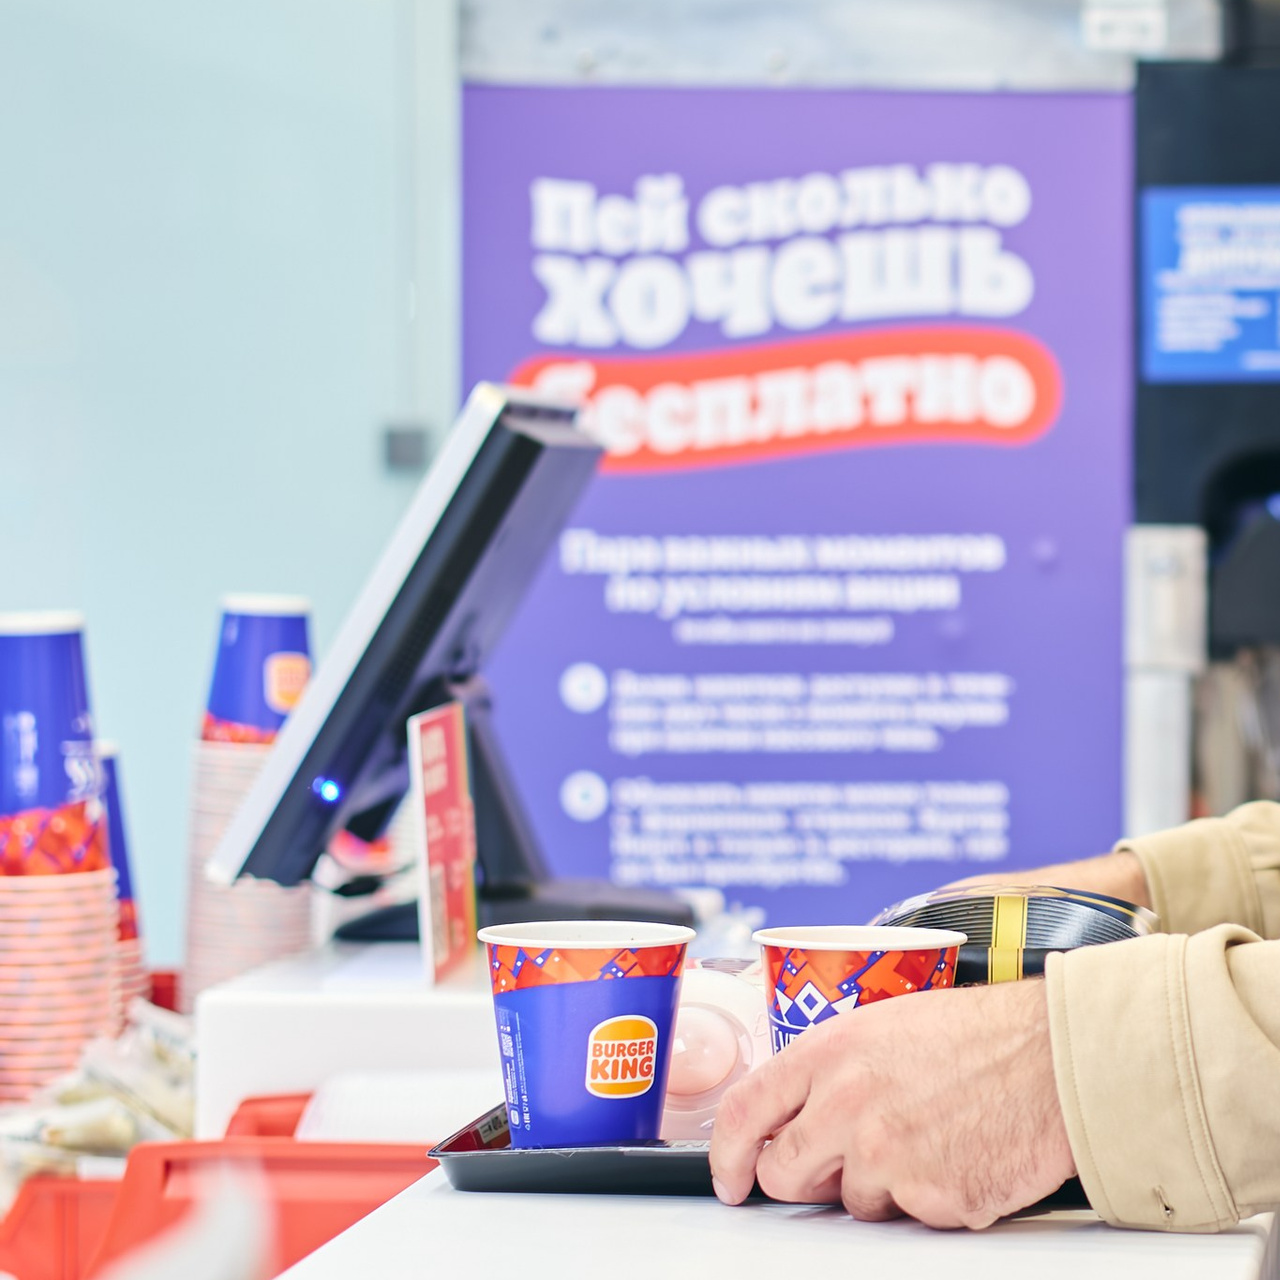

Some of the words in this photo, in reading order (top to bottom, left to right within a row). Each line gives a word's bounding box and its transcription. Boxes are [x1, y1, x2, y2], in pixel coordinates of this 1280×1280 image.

[530, 173, 689, 254] Пей
[698, 162, 1032, 246] сколько
[592, 1040, 654, 1057] BURGER
[591, 1056, 654, 1080] KING
